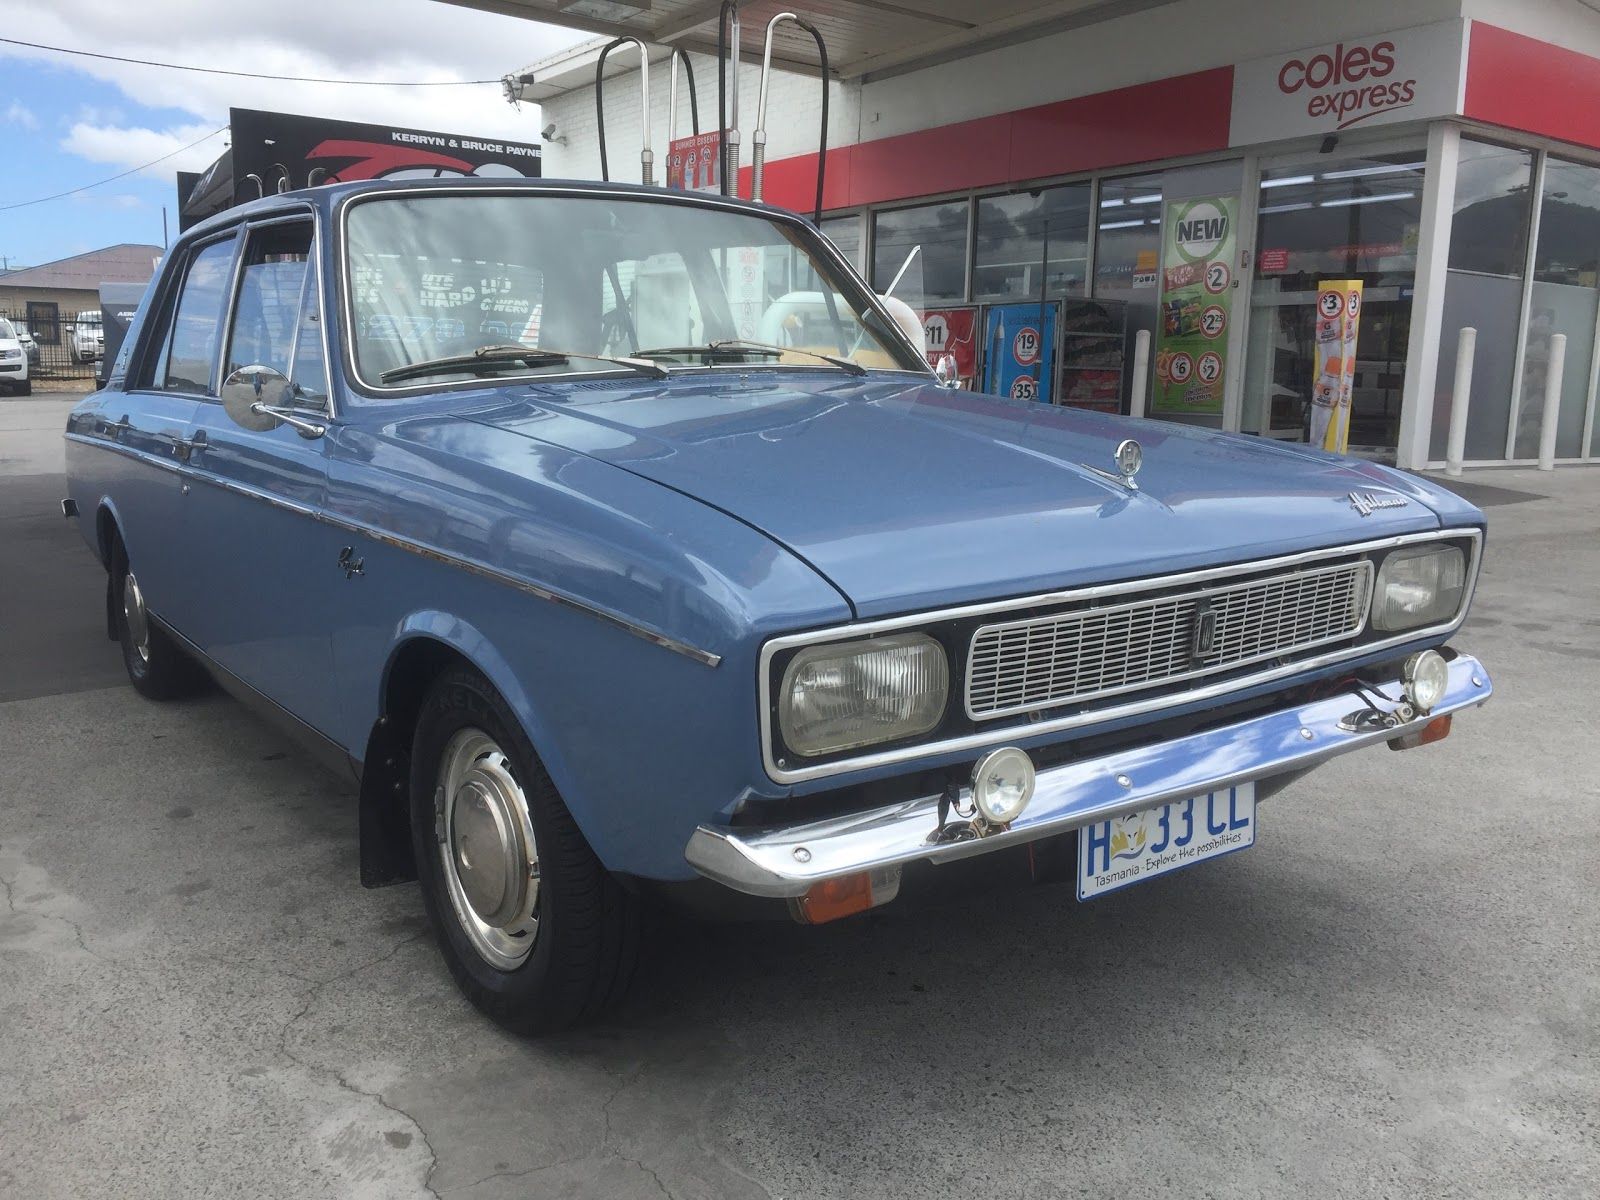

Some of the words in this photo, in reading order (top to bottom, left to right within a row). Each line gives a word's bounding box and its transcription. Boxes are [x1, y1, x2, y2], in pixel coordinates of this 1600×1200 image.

[1278, 41, 1395, 94] coles
[1307, 79, 1417, 122] express
[392, 131, 446, 147] KERRYN
[449, 139, 458, 148] &
[461, 140, 504, 153] BRUCE
[506, 146, 541, 158] PAYNE
[1178, 217, 1226, 242] NEW
[1207, 268, 1223, 287] $2
[419, 286, 476, 308] HARD
[1323, 295, 1337, 310] $3
[1350, 294, 1357, 309] $3
[925, 325, 943, 345] $11
[1017, 334, 1034, 350] $19
[1175, 362, 1187, 375] $6
[1203, 365, 1215, 380] $2
[1013, 383, 1031, 399] $35
[1087, 820, 1111, 877] H
[1095, 864, 1140, 888] Tasmania
[1146, 851, 1178, 871] Explore
[1179, 845, 1195, 860] the
[1197, 832, 1242, 856] possibilities
